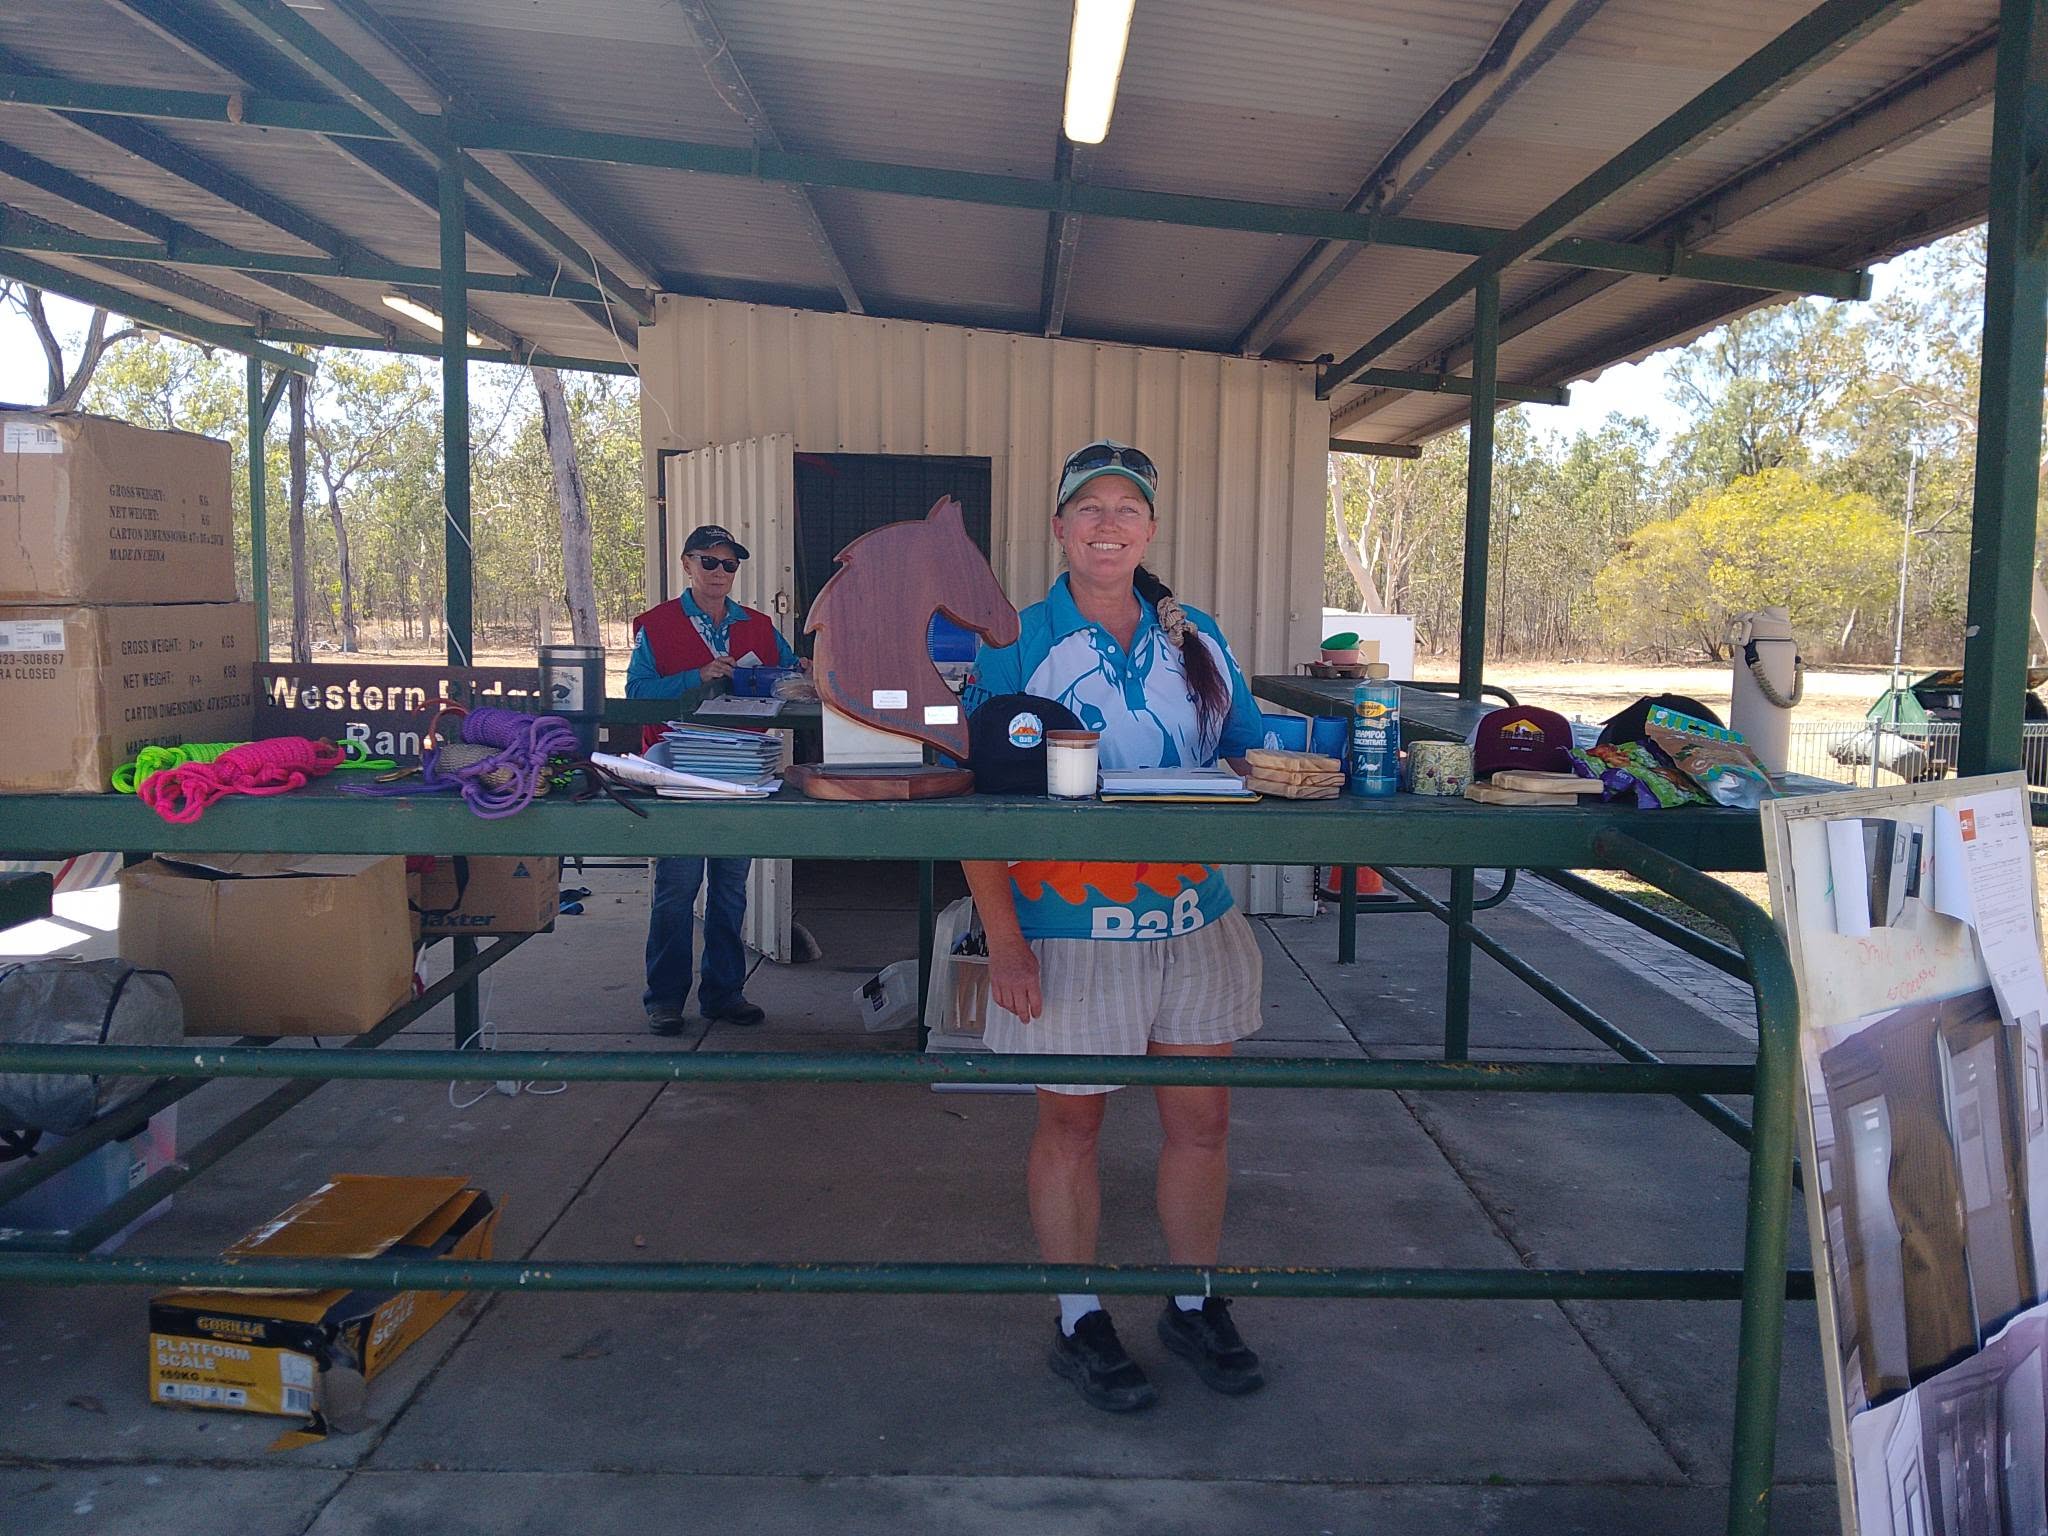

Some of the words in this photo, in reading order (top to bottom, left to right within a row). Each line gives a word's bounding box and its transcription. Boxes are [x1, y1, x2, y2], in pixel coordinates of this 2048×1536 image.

[109, 506, 127, 519] NET
[109, 527, 143, 541] CARTON
[109, 548, 133, 561] MADE
[143, 550, 165, 561] CHINA
[121, 640, 149, 656] GROSS
[222, 635, 235, 649] KGS
[15, 667, 56, 680] CLOSED
[224, 664, 237, 678] KGS
[123, 673, 140, 689] NET
[262, 676, 427, 712] Western
[125, 704, 159, 722] CARTON
[1355, 730, 1386, 739] SHAMPOO
[197, 1316, 266, 1339] GORILLA
[156, 1339, 251, 1361] PLATFORM
[157, 1353, 216, 1371] SCALE
